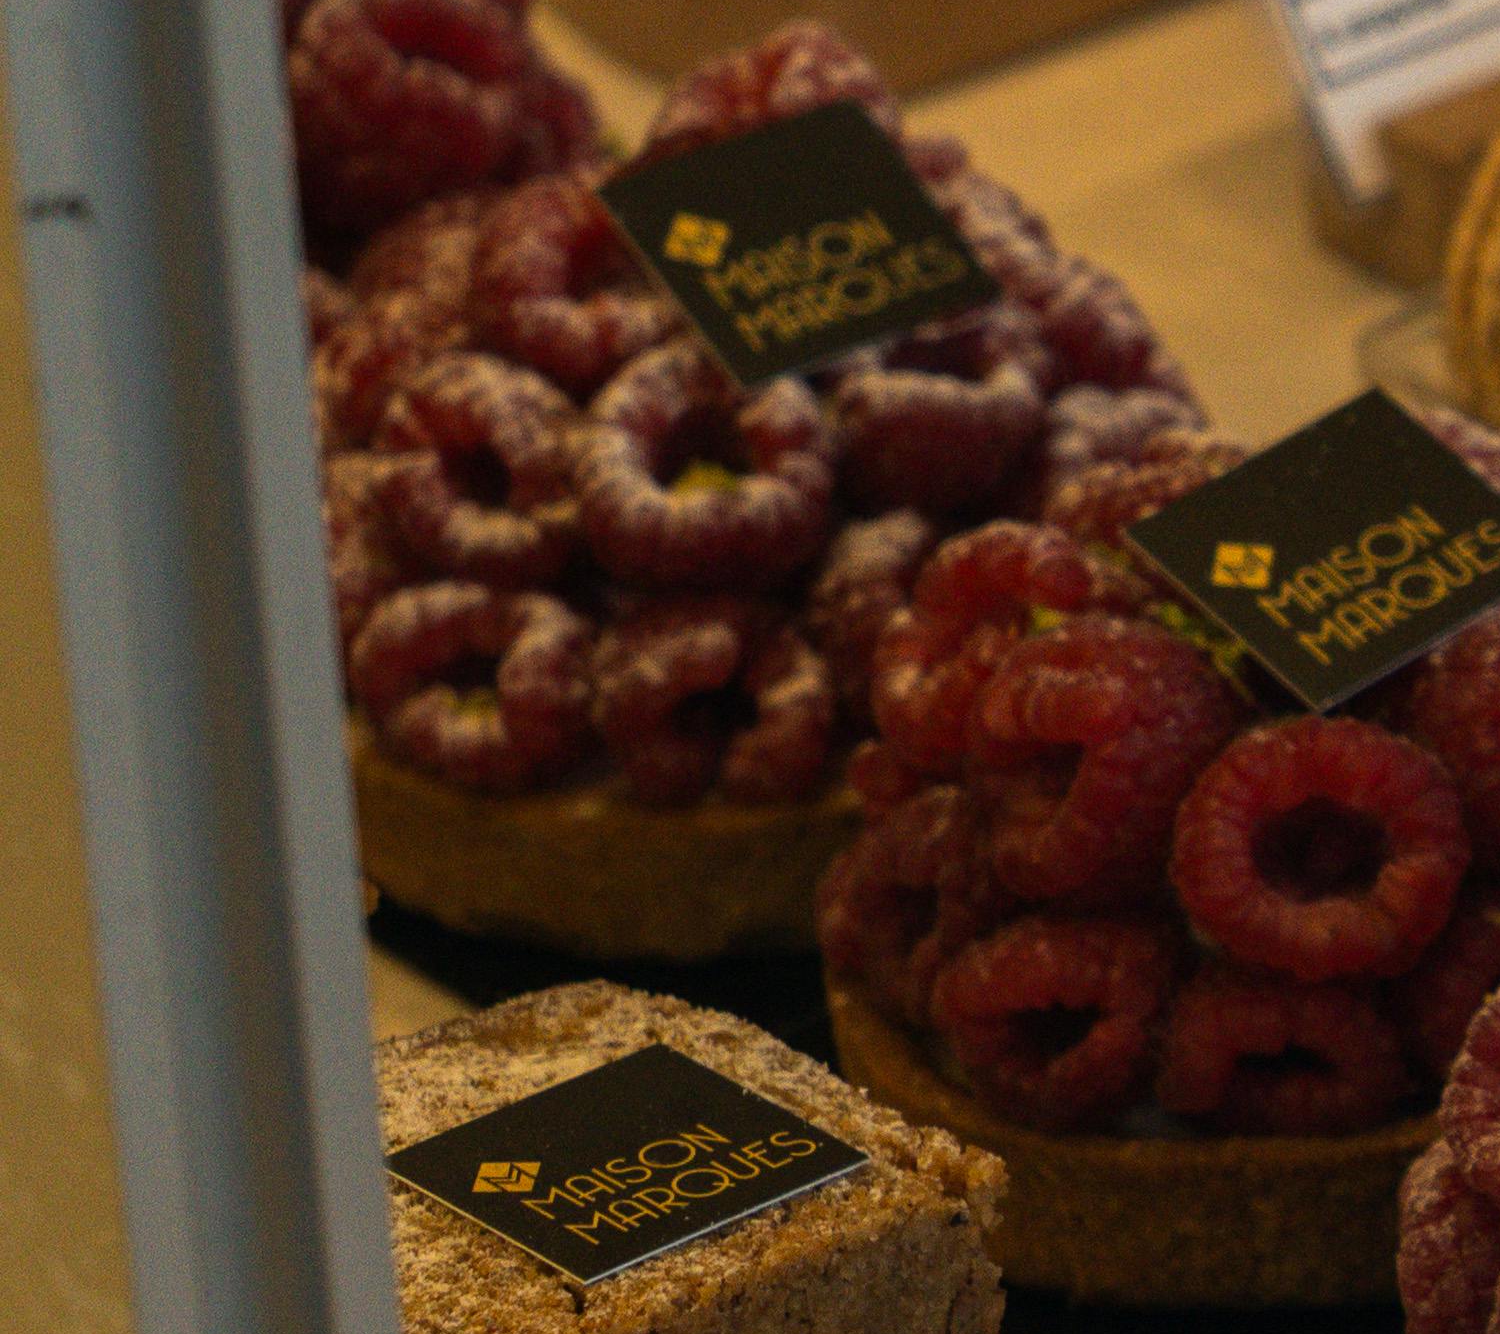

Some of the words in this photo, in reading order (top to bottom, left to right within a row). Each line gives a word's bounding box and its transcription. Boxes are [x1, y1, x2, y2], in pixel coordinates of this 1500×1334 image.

[700, 211, 894, 306] MAISON
[735, 239, 968, 349] MARQUES
[1257, 505, 1446, 628] MAISON
[521, 1123, 733, 1220] MAISON
[563, 1131, 818, 1246] MARQUES
